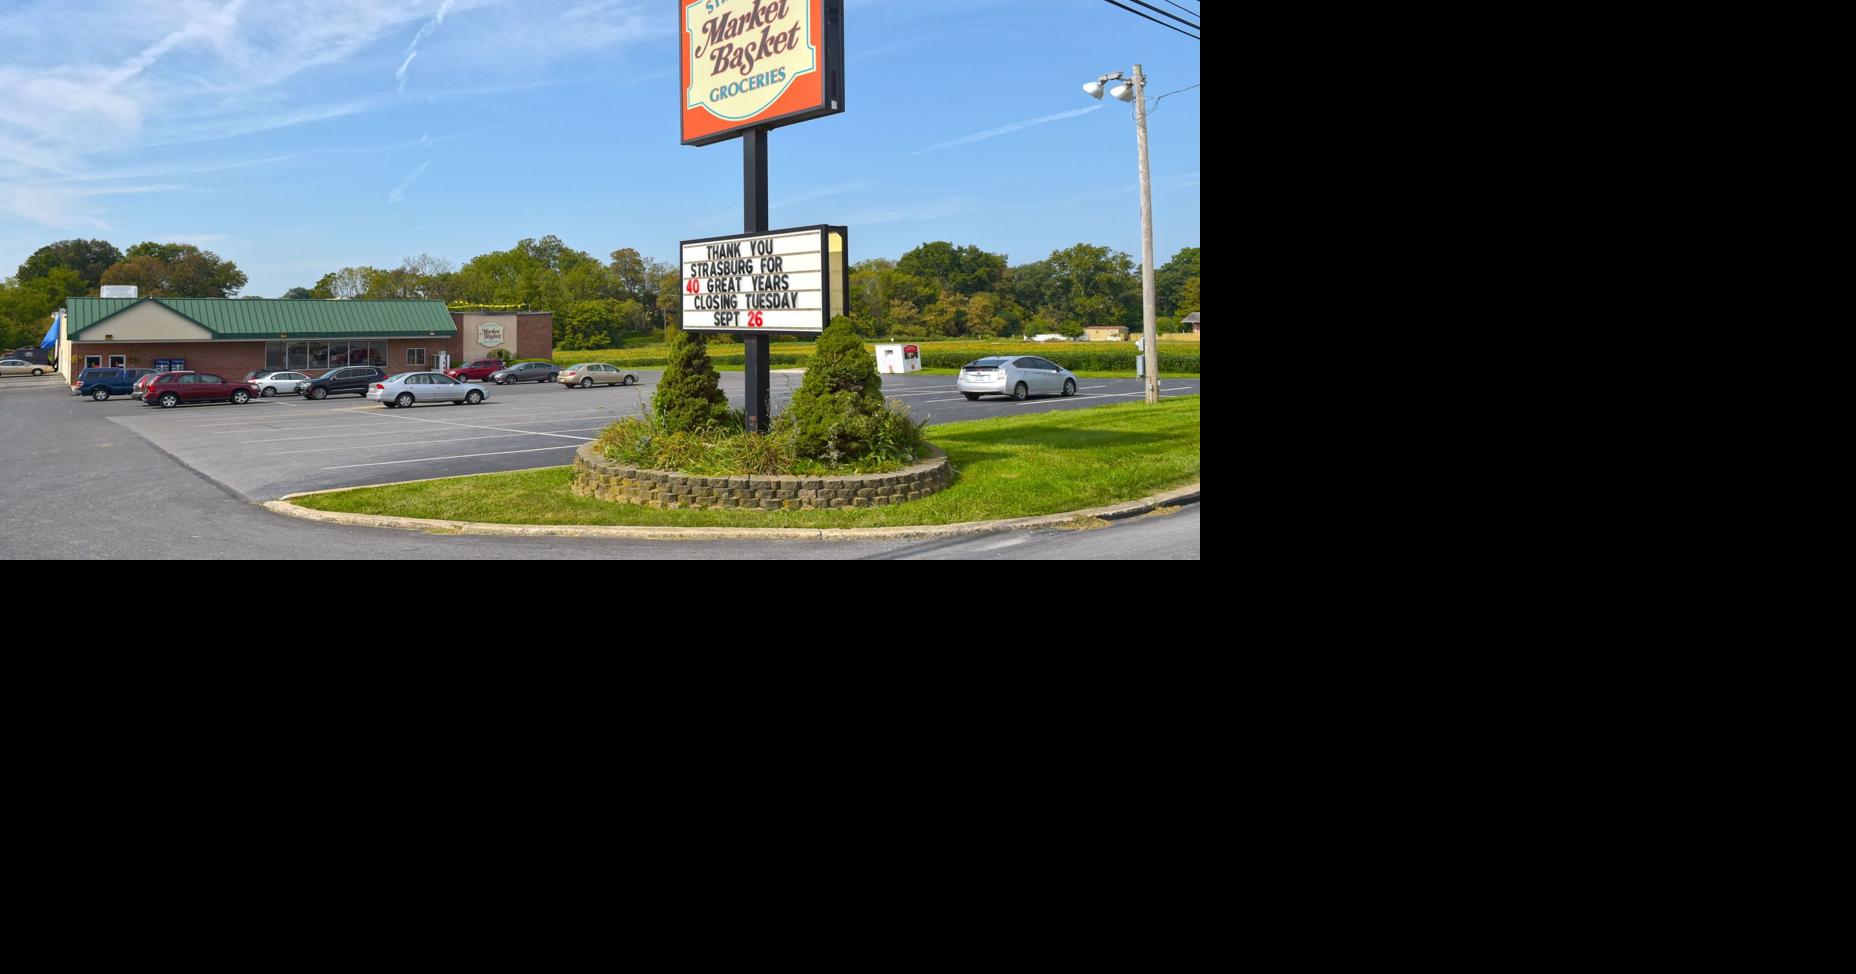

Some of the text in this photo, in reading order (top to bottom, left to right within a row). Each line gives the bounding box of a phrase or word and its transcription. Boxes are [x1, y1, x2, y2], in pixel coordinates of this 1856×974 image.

[695, 0, 790, 58] Market
[710, 21, 801, 76] Basket
[709, 67, 786, 102] GROCERIES
[707, 239, 774, 260] THANK YOU
[691, 257, 783, 278] STRASBURG FOR
[686, 274, 789, 294] 40 GREAT YEARS
[694, 292, 798, 310] CLOSING TUESDAY
[714, 311, 763, 327] SEPT 26
